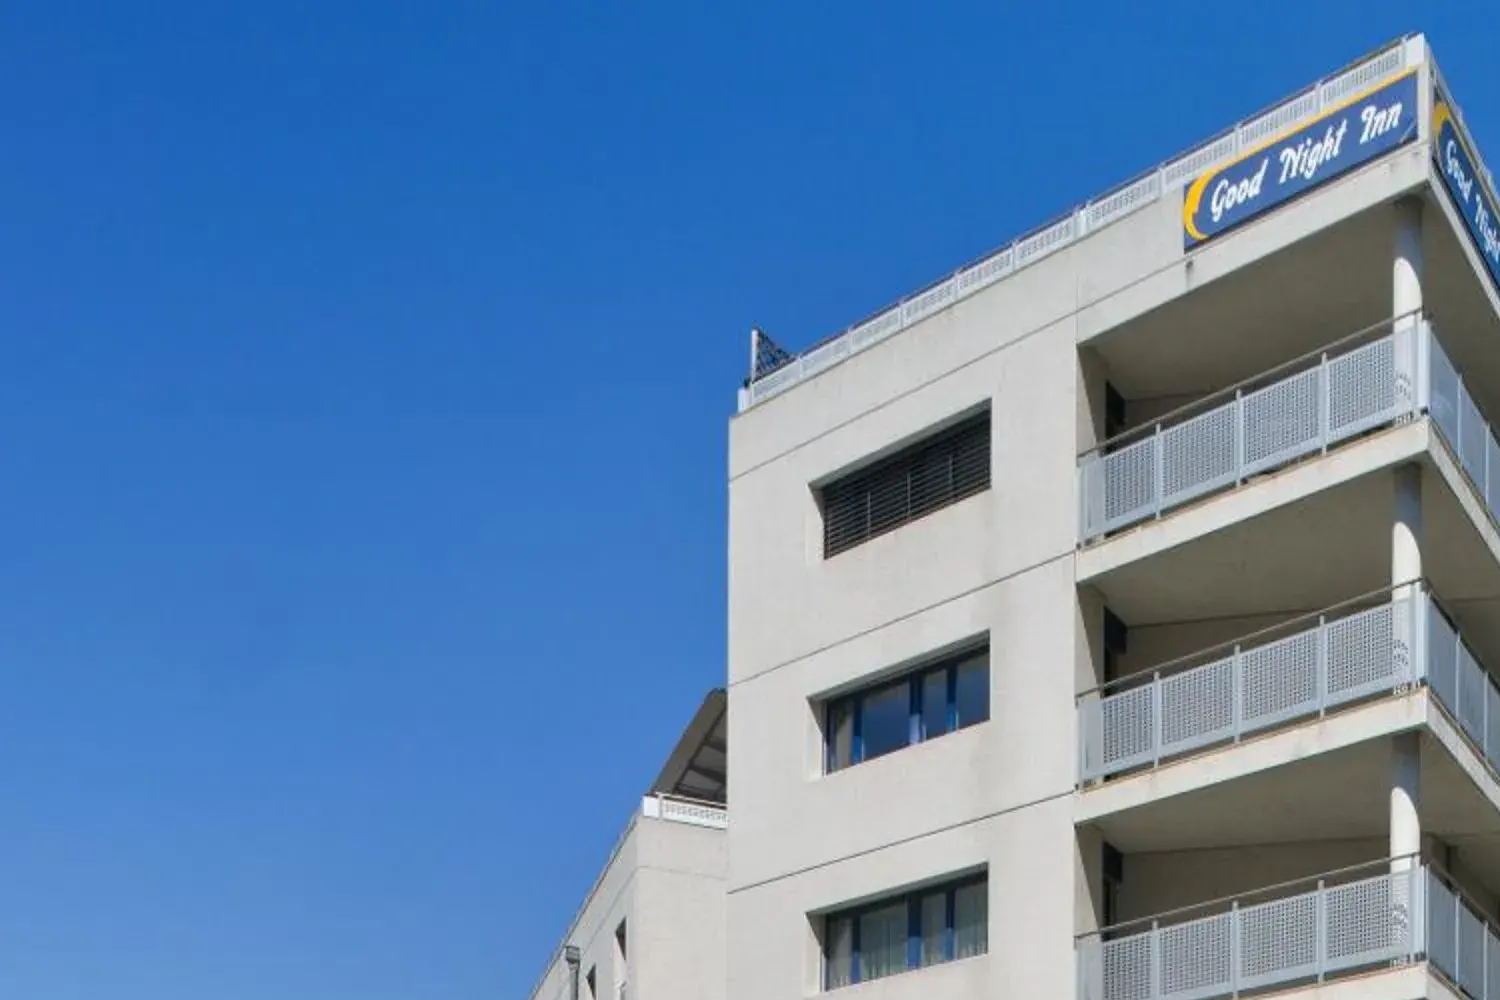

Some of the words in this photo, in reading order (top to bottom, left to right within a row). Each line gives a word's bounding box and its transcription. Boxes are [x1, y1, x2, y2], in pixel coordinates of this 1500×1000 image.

[1210, 155, 1269, 222] Good
[1279, 117, 1349, 185] Night
[1359, 101, 1403, 144] Inn
[1447, 138, 1473, 204] Good
